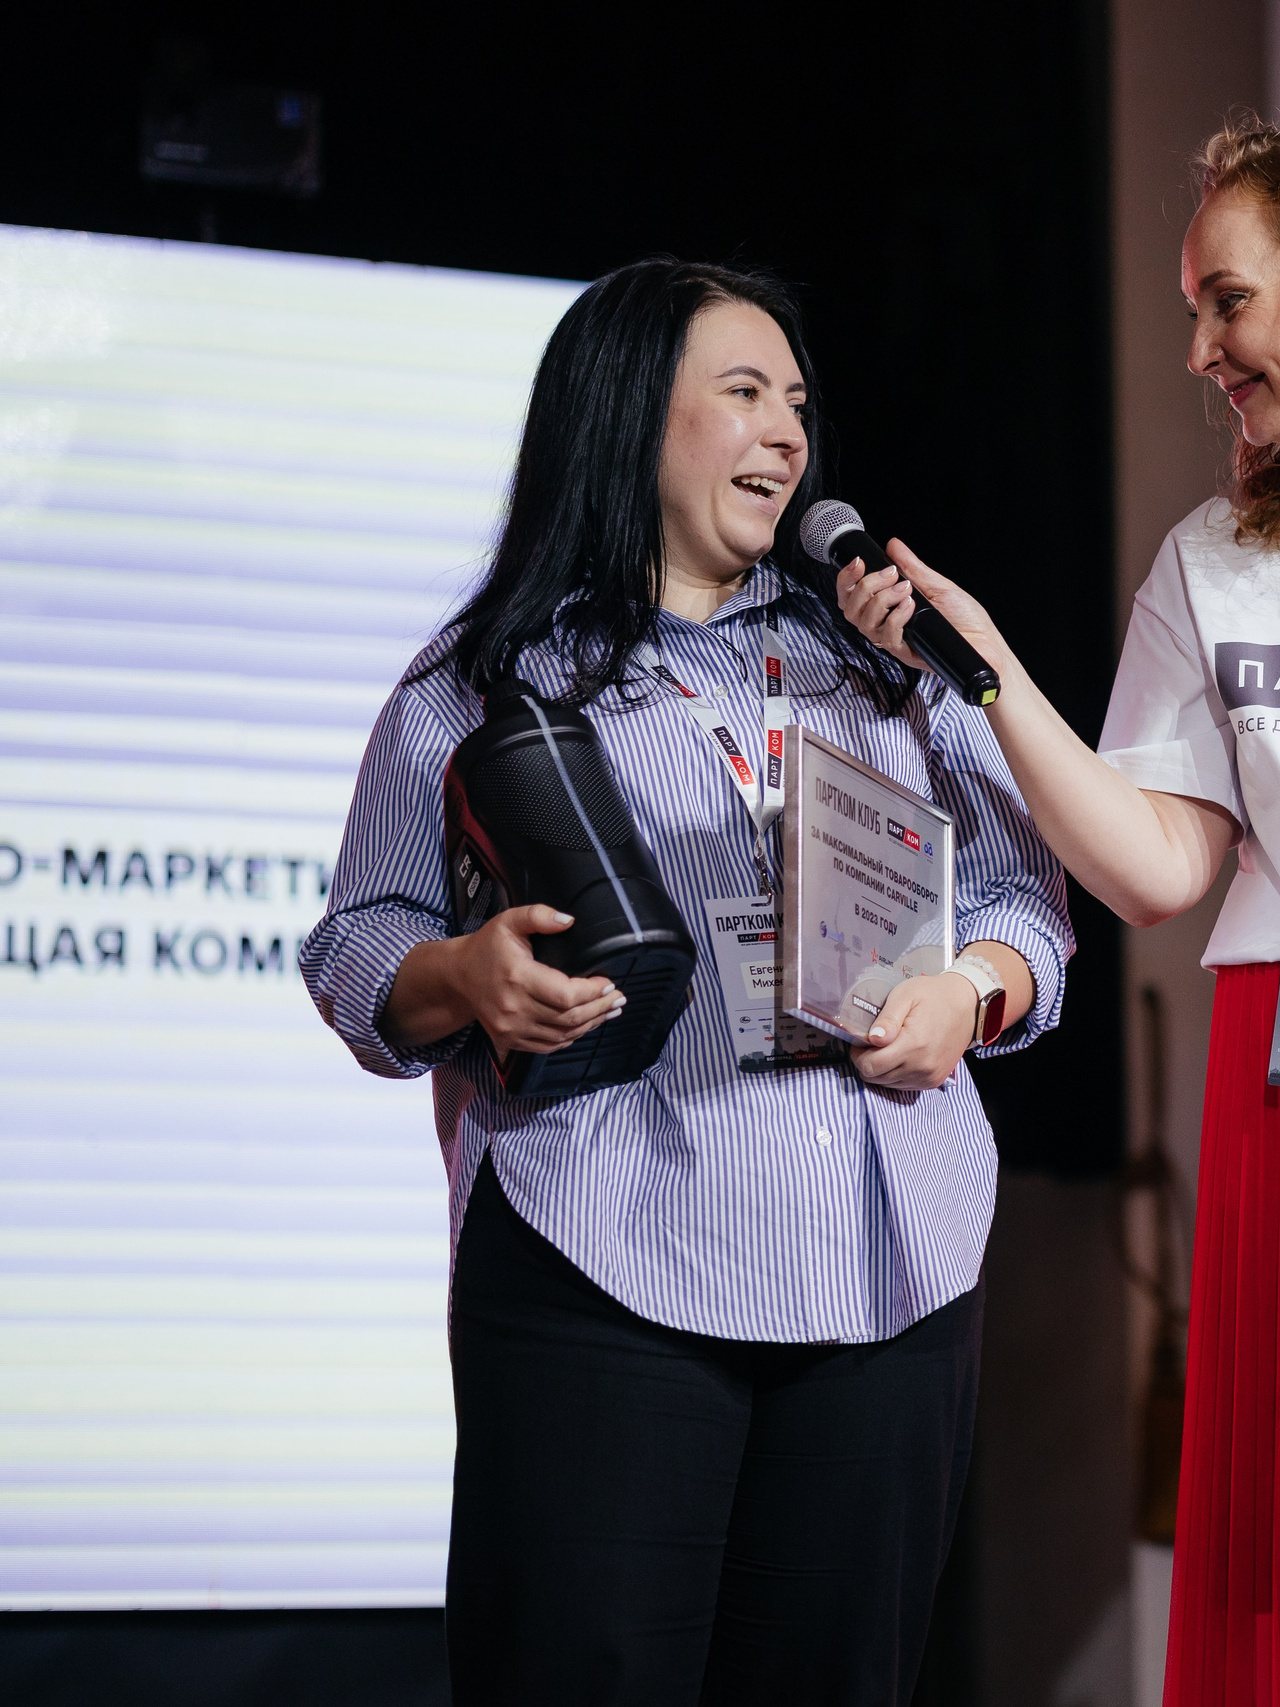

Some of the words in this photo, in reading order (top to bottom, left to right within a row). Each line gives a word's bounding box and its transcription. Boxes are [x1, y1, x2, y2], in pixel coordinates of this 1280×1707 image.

[770, 678, 778, 695] ПАРТ
[1237, 717, 1265, 734] ВСЕ
[717, 730, 736, 752] ПАРТ
[736, 760, 751, 782] КОМ
[770, 760, 778, 785] ПАРТ
[816, 777, 856, 822] ПАРТКОМ
[858, 800, 880, 836] КЛУБ
[888, 822, 903, 838] ПАРТ
[908, 834, 918, 846] КОМ
[459, 854, 472, 878] CR
[811, 825, 820, 841] ЗА
[822, 832, 883, 875] МАКСИМАЛЬНЫЙ
[885, 866, 938, 905] ТОВАРООБОРОТ
[834, 858, 843, 872] ПО
[846, 864, 885, 895] КОМПАНИИ
[886, 886, 918, 913] CARVILLE
[715, 913, 775, 932] ПАРТКОМ
[855, 903, 859, 916] В
[862, 908, 878, 925] 2023
[880, 916, 898, 936] ГОДУ
[155, 930, 302, 974] КОМ
